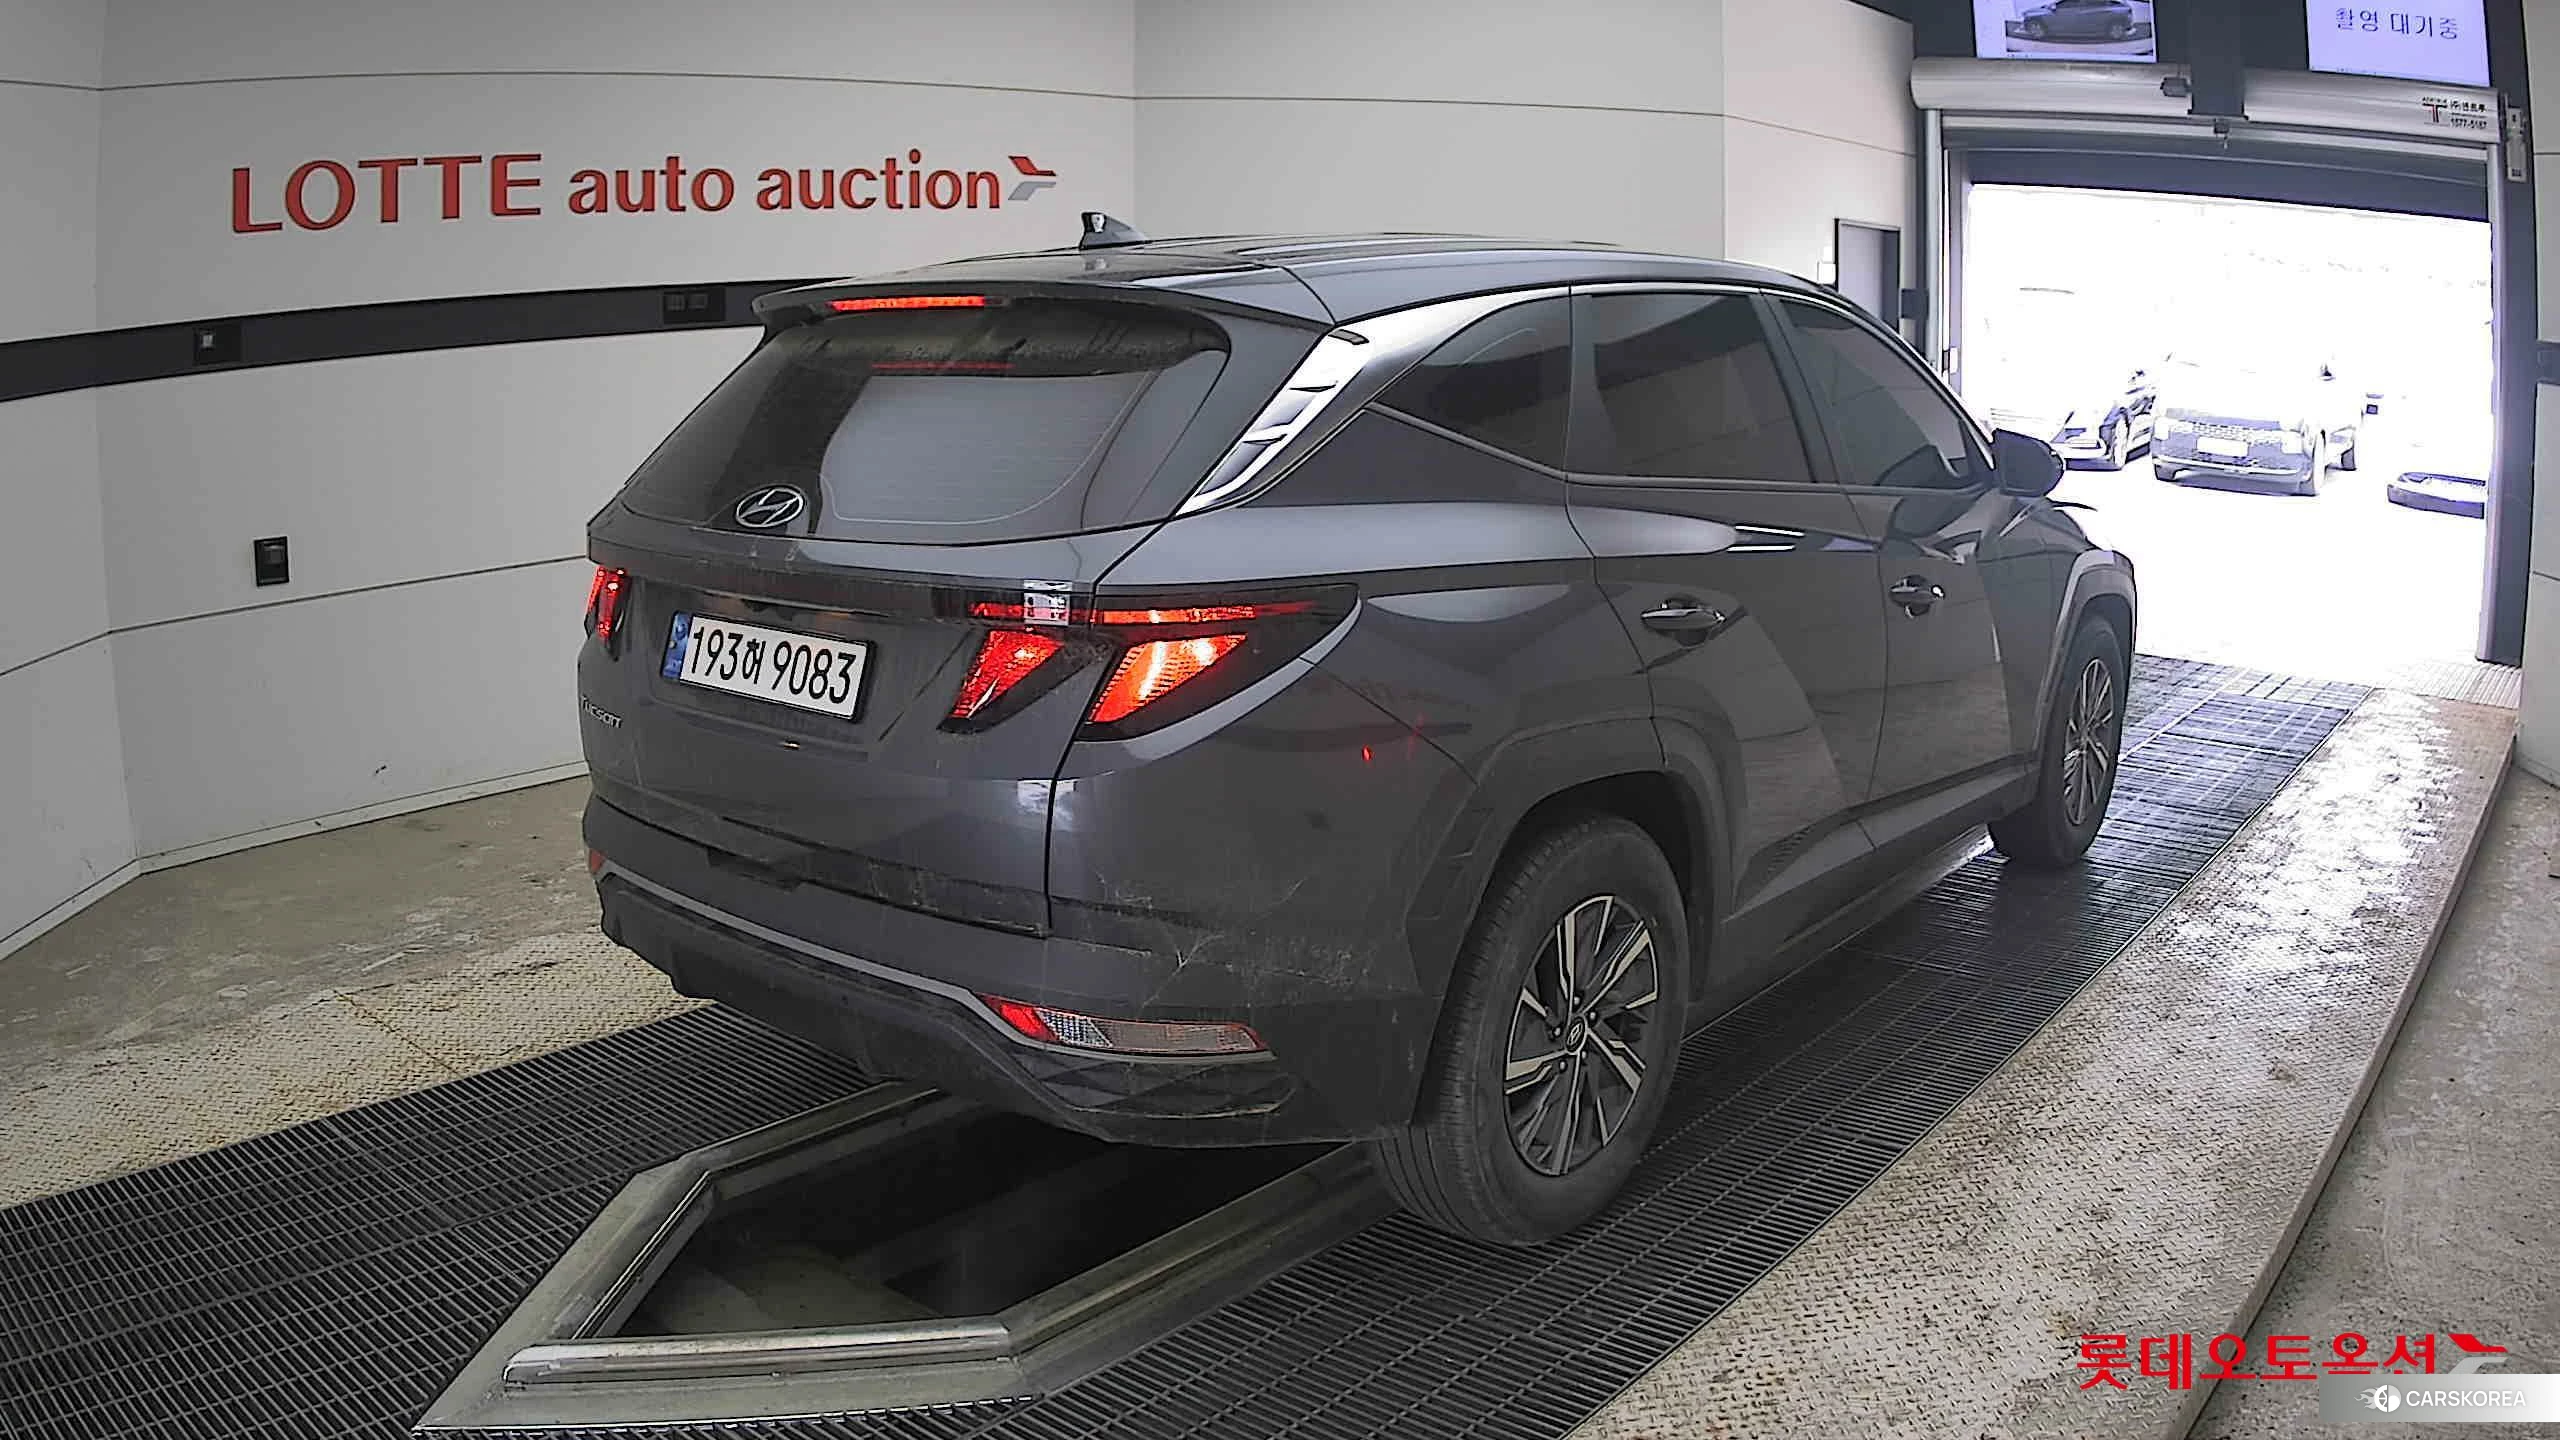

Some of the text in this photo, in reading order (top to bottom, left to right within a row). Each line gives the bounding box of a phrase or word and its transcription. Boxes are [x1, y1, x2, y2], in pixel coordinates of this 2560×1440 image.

[232, 148, 1001, 234] LOTTE auto auction
[691, 626, 857, 704] 193허 9083
